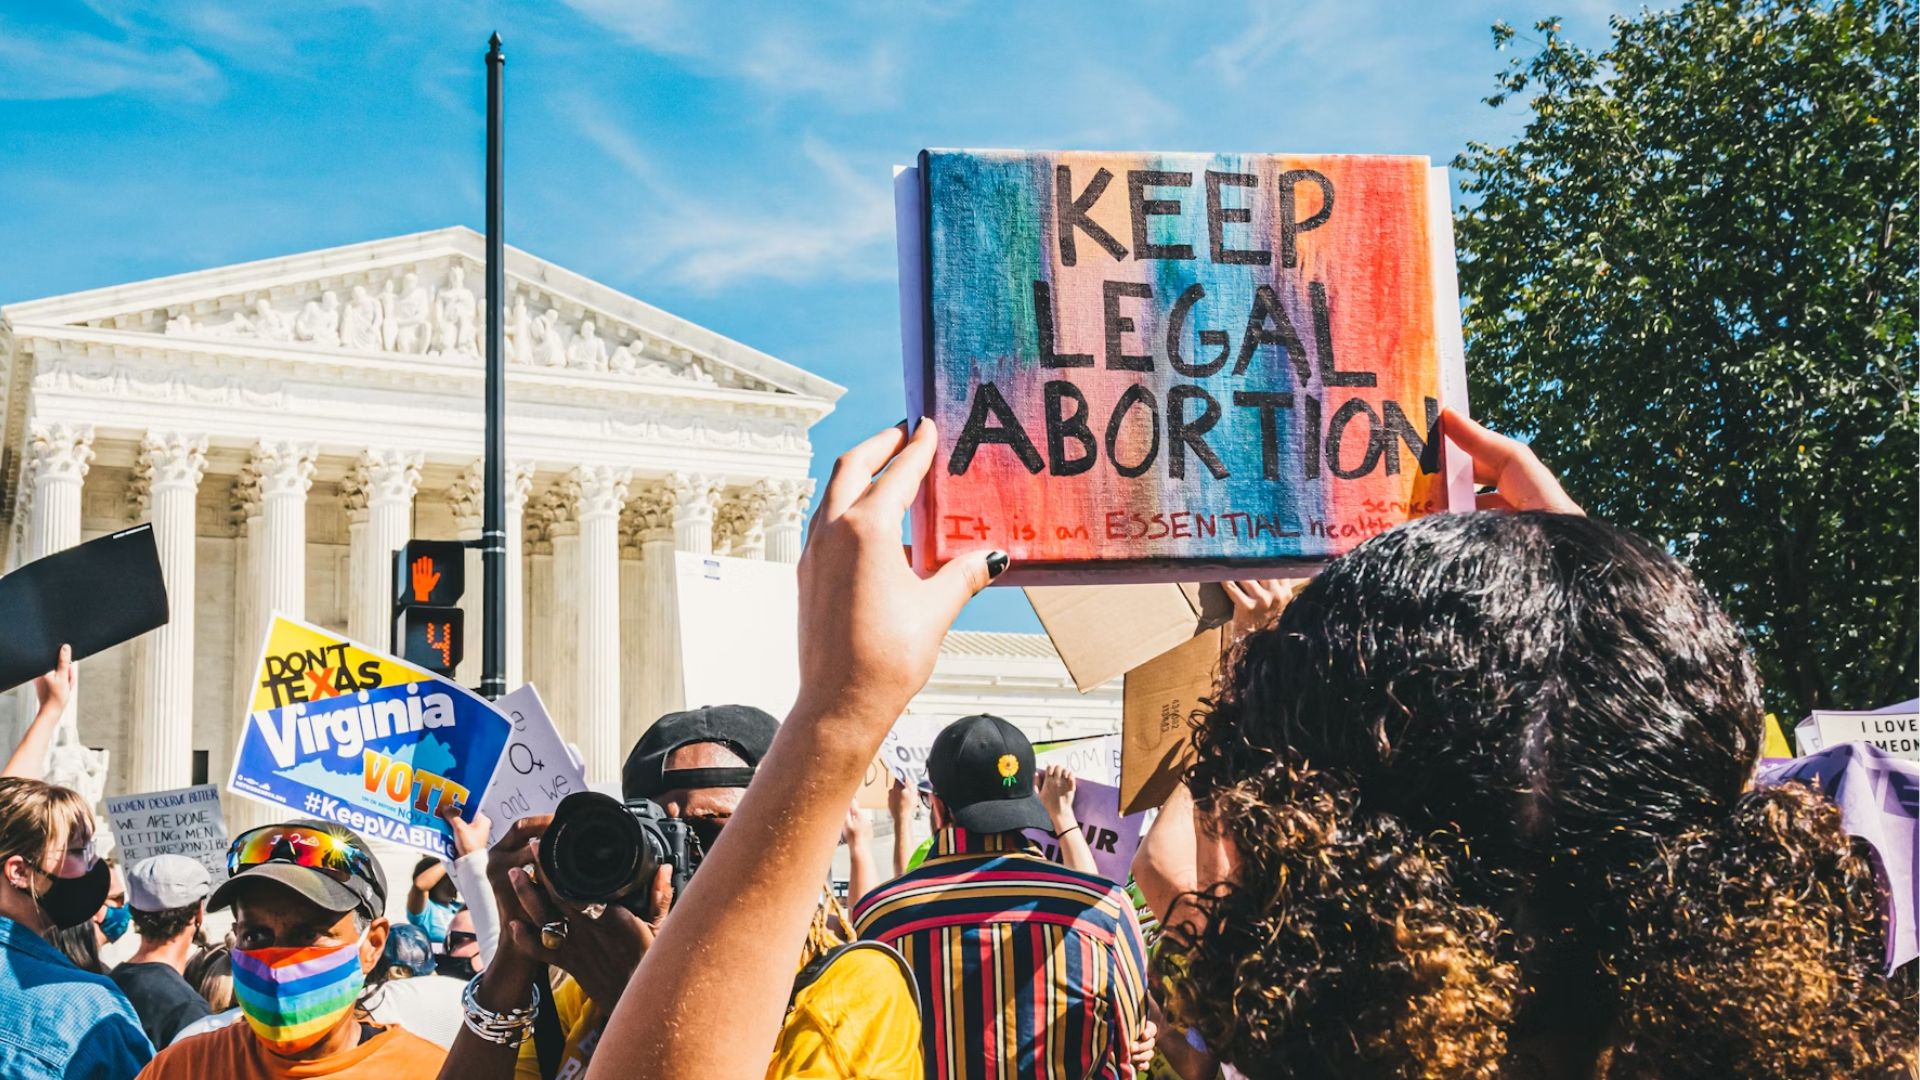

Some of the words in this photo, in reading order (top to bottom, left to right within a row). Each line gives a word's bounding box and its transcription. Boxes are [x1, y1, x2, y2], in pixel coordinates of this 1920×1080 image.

[1056, 164, 1335, 268] KEEP
[1033, 280, 1377, 388] LEGAL
[948, 380, 1443, 481] ABORTION
[1363, 498, 1435, 514] service
[944, 514, 991, 540] It
[1013, 515, 1036, 541] is
[1056, 523, 1090, 540] an
[1106, 511, 1300, 539] ESSENTIAL
[1308, 515, 1394, 539] health
[265, 642, 350, 677] DON'T
[427, 622, 451, 667] 4
[261, 661, 382, 708] TEXAS
[252, 682, 456, 769] Virginia
[1861, 720, 1866, 733] I
[1875, 719, 1918, 733] LOVE
[1864, 739, 1919, 752] MEON
[361, 747, 471, 820] VOTE
[109, 800, 145, 814] WOMEN
[149, 793, 185, 809] DESERVE
[188, 788, 219, 804] BETTER
[398, 807, 422, 824] NOV
[500, 786, 530, 820] and
[116, 817, 139, 830] WE
[146, 814, 173, 829] ARE
[175, 810, 209, 826] DONE
[120, 831, 180, 847] LETTING
[185, 827, 213, 840] MEN
[303, 791, 456, 859] #KeepVABlue
